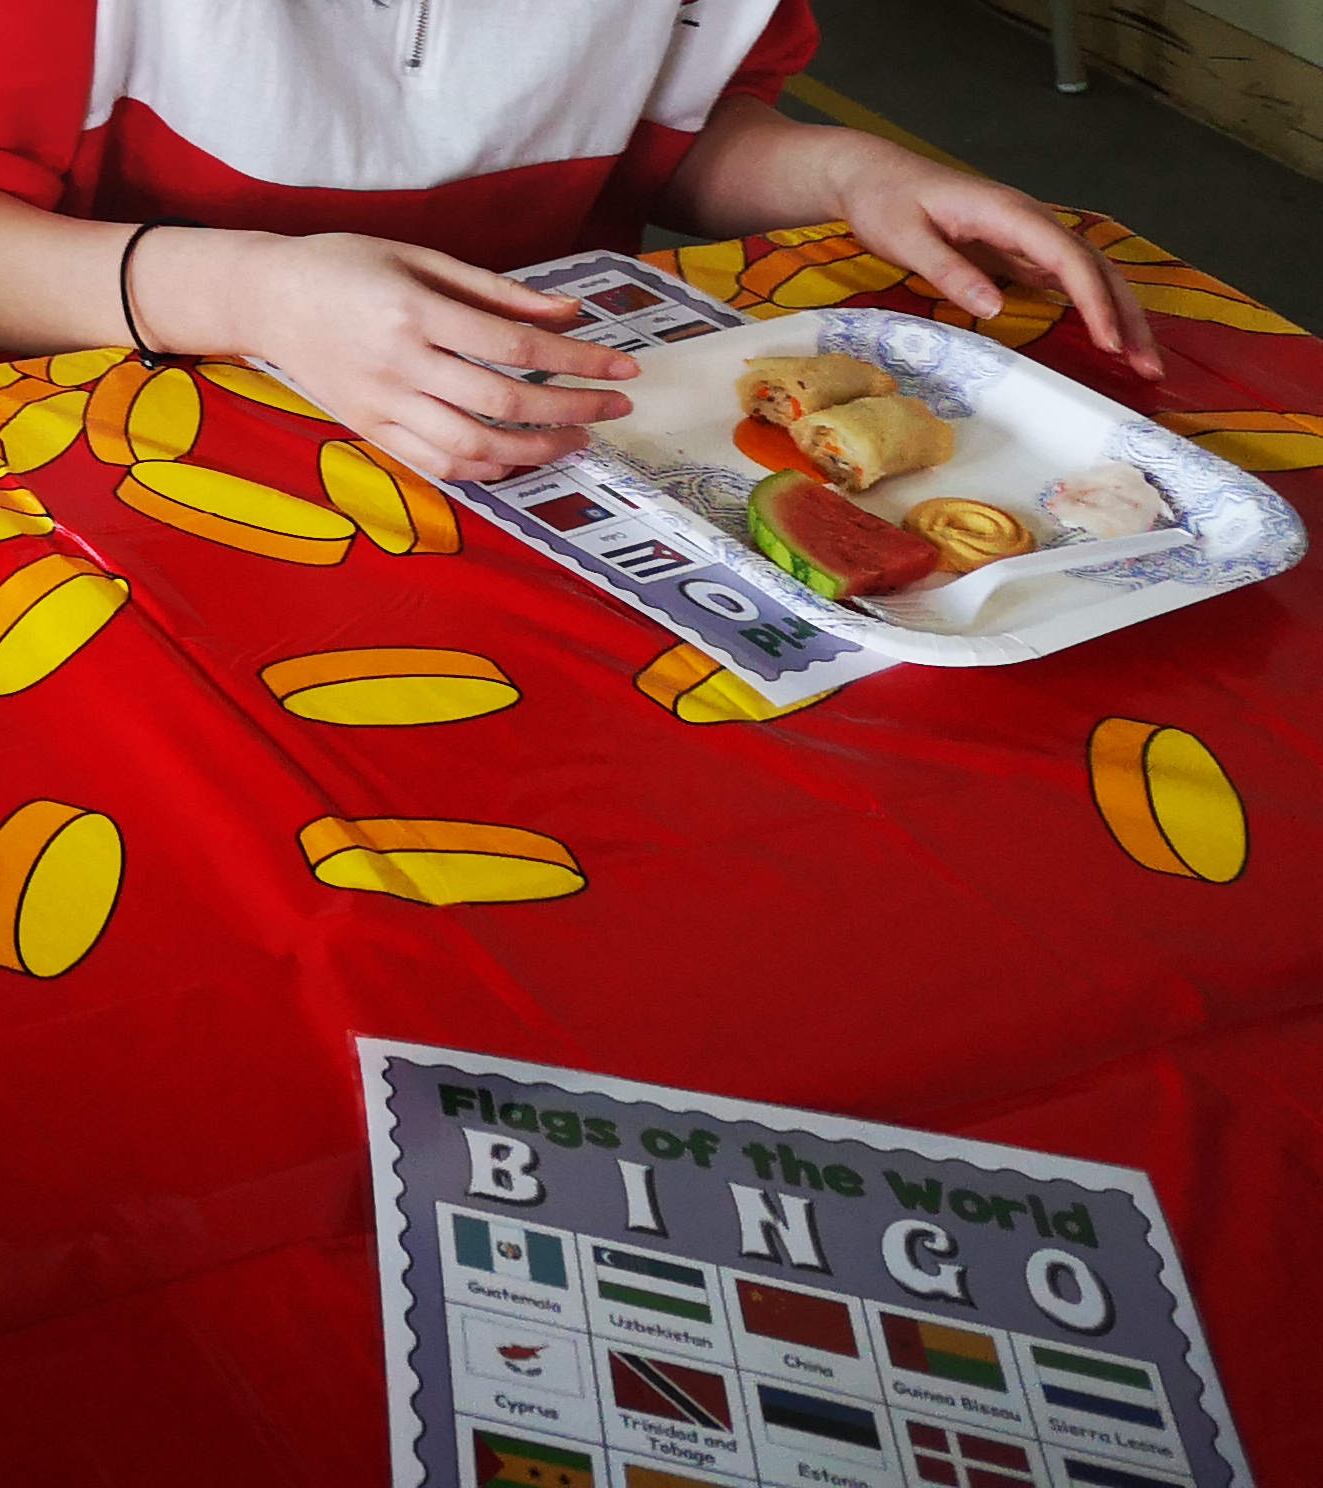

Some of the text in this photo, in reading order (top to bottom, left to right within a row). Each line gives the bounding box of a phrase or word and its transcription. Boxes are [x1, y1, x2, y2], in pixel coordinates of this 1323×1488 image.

[438, 1083, 1100, 1249] Flags of the World
[467, 1280, 562, 1313] Guatemala
[608, 1312, 714, 1349] Uzbekistan
[782, 1351, 836, 1379] China
[494, 1392, 560, 1422] Cyprus
[892, 1379, 1023, 1424] Guinea Bissau
[619, 1413, 739, 1454] Trinidad and
[648, 1436, 717, 1467] Tobago
[1048, 1415, 1175, 1459] Sierra Leone
